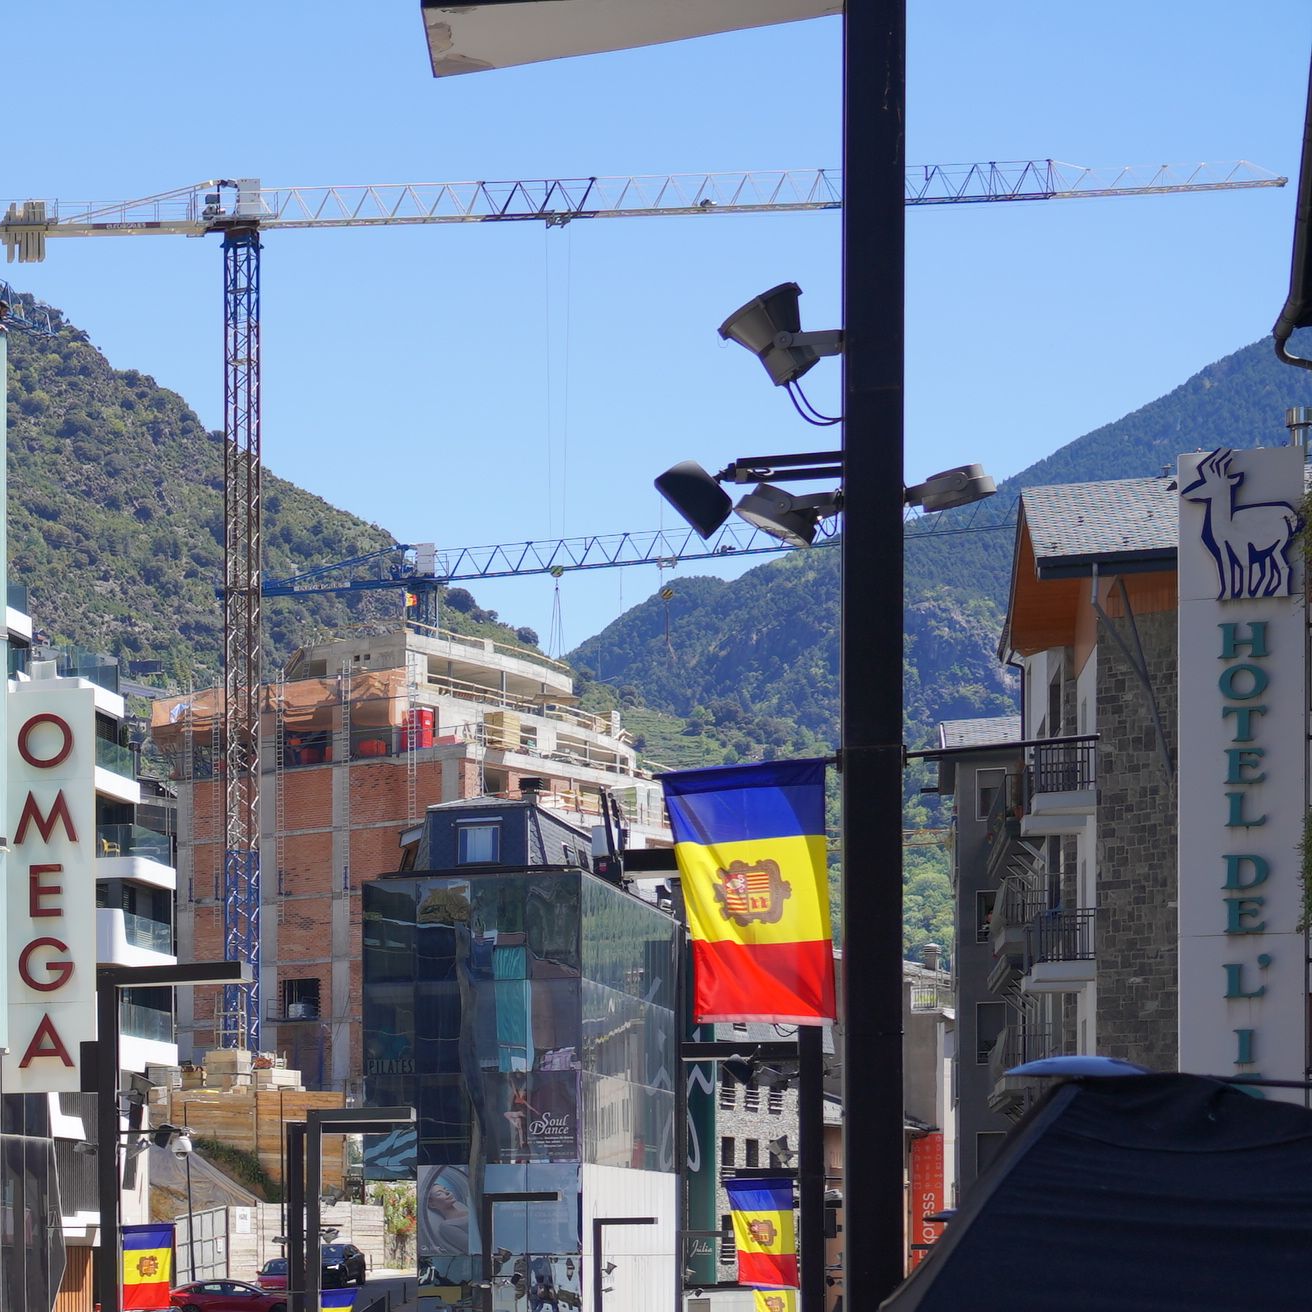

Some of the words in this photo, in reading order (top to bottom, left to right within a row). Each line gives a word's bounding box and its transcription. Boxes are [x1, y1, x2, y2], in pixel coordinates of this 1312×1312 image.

[1217, 620, 1270, 829] HOTEL
[13, 713, 79, 1069] OMEGA
[1224, 853, 1271, 935] DE
[1223, 954, 1272, 1092] L'I
[369, 1059, 413, 1073] PILATES
[529, 1120, 569, 1135] Dance
[542, 1112, 570, 1127] Soul
